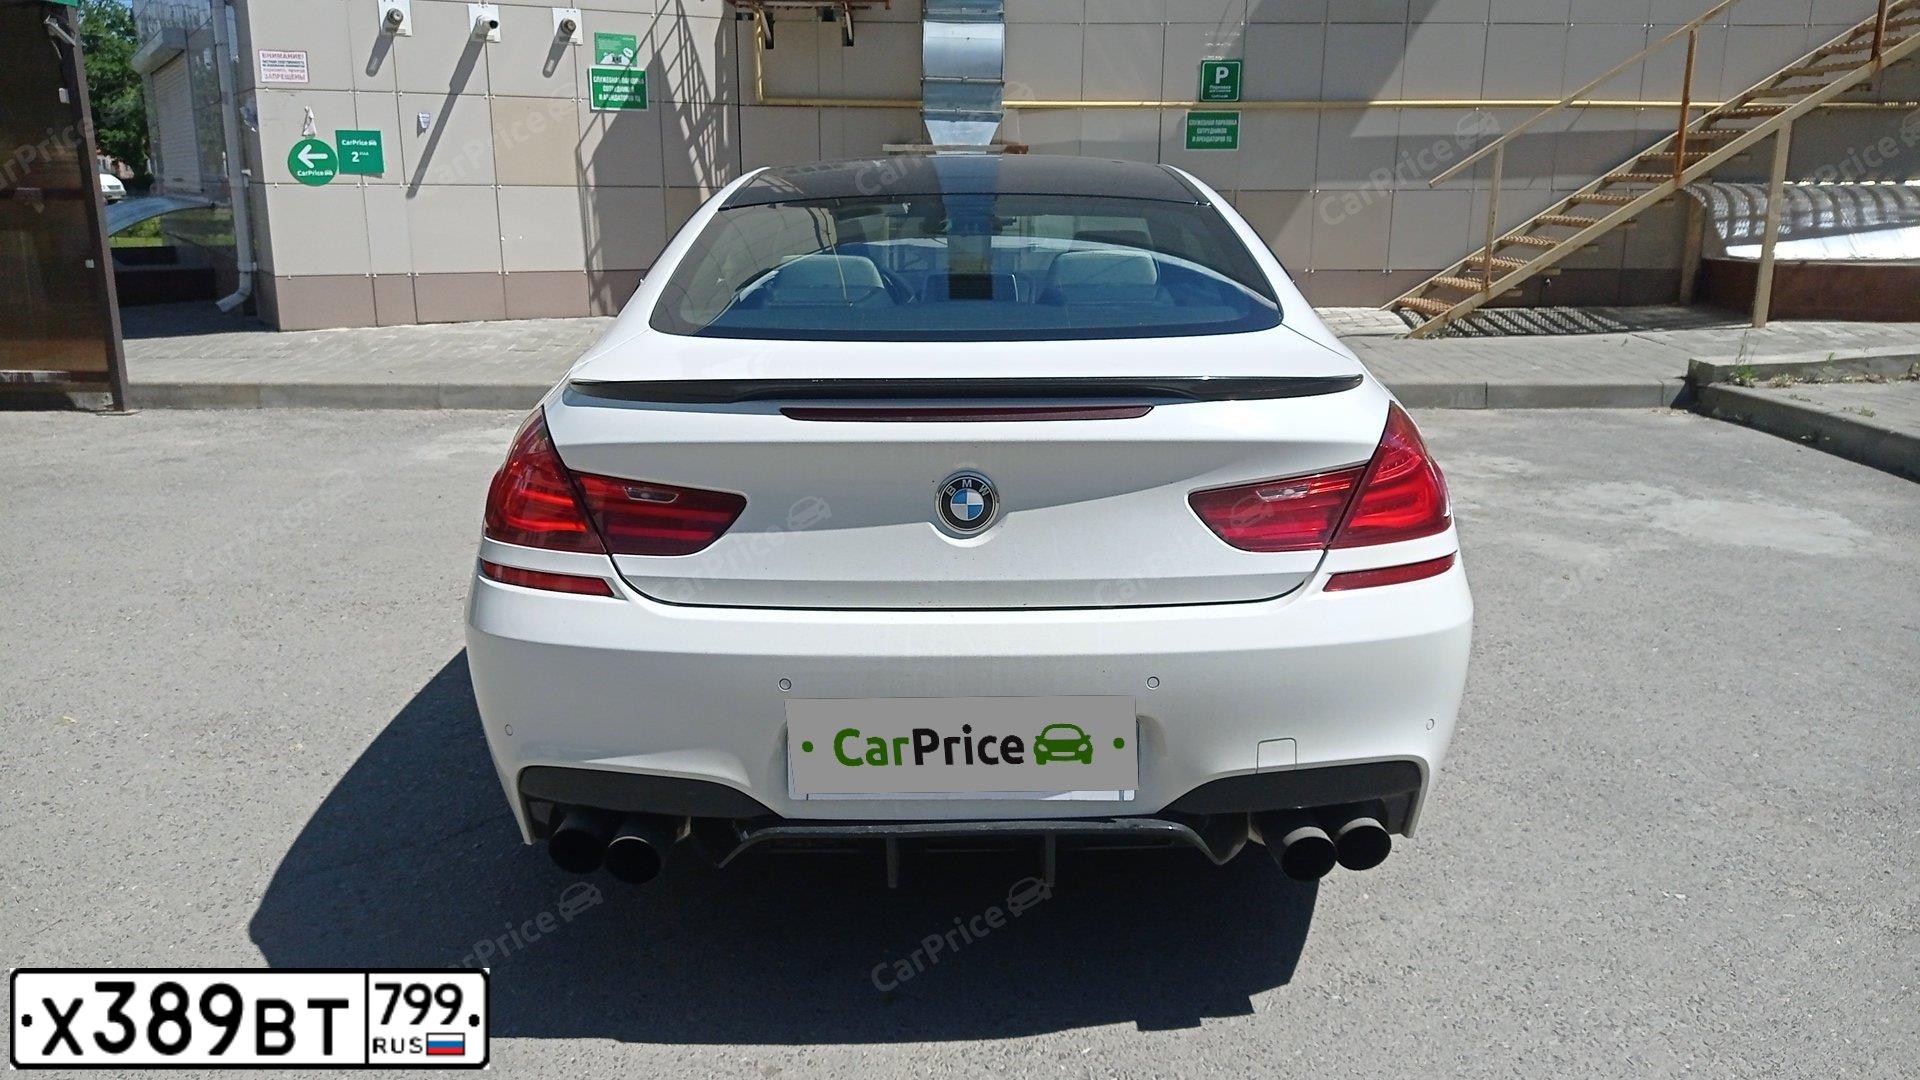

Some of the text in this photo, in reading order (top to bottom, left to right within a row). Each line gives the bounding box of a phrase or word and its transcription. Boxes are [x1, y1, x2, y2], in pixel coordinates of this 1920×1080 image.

[1215, 66, 1229, 84] P
[351, 151, 360, 163] 2
[946, 479, 990, 497] BMW
